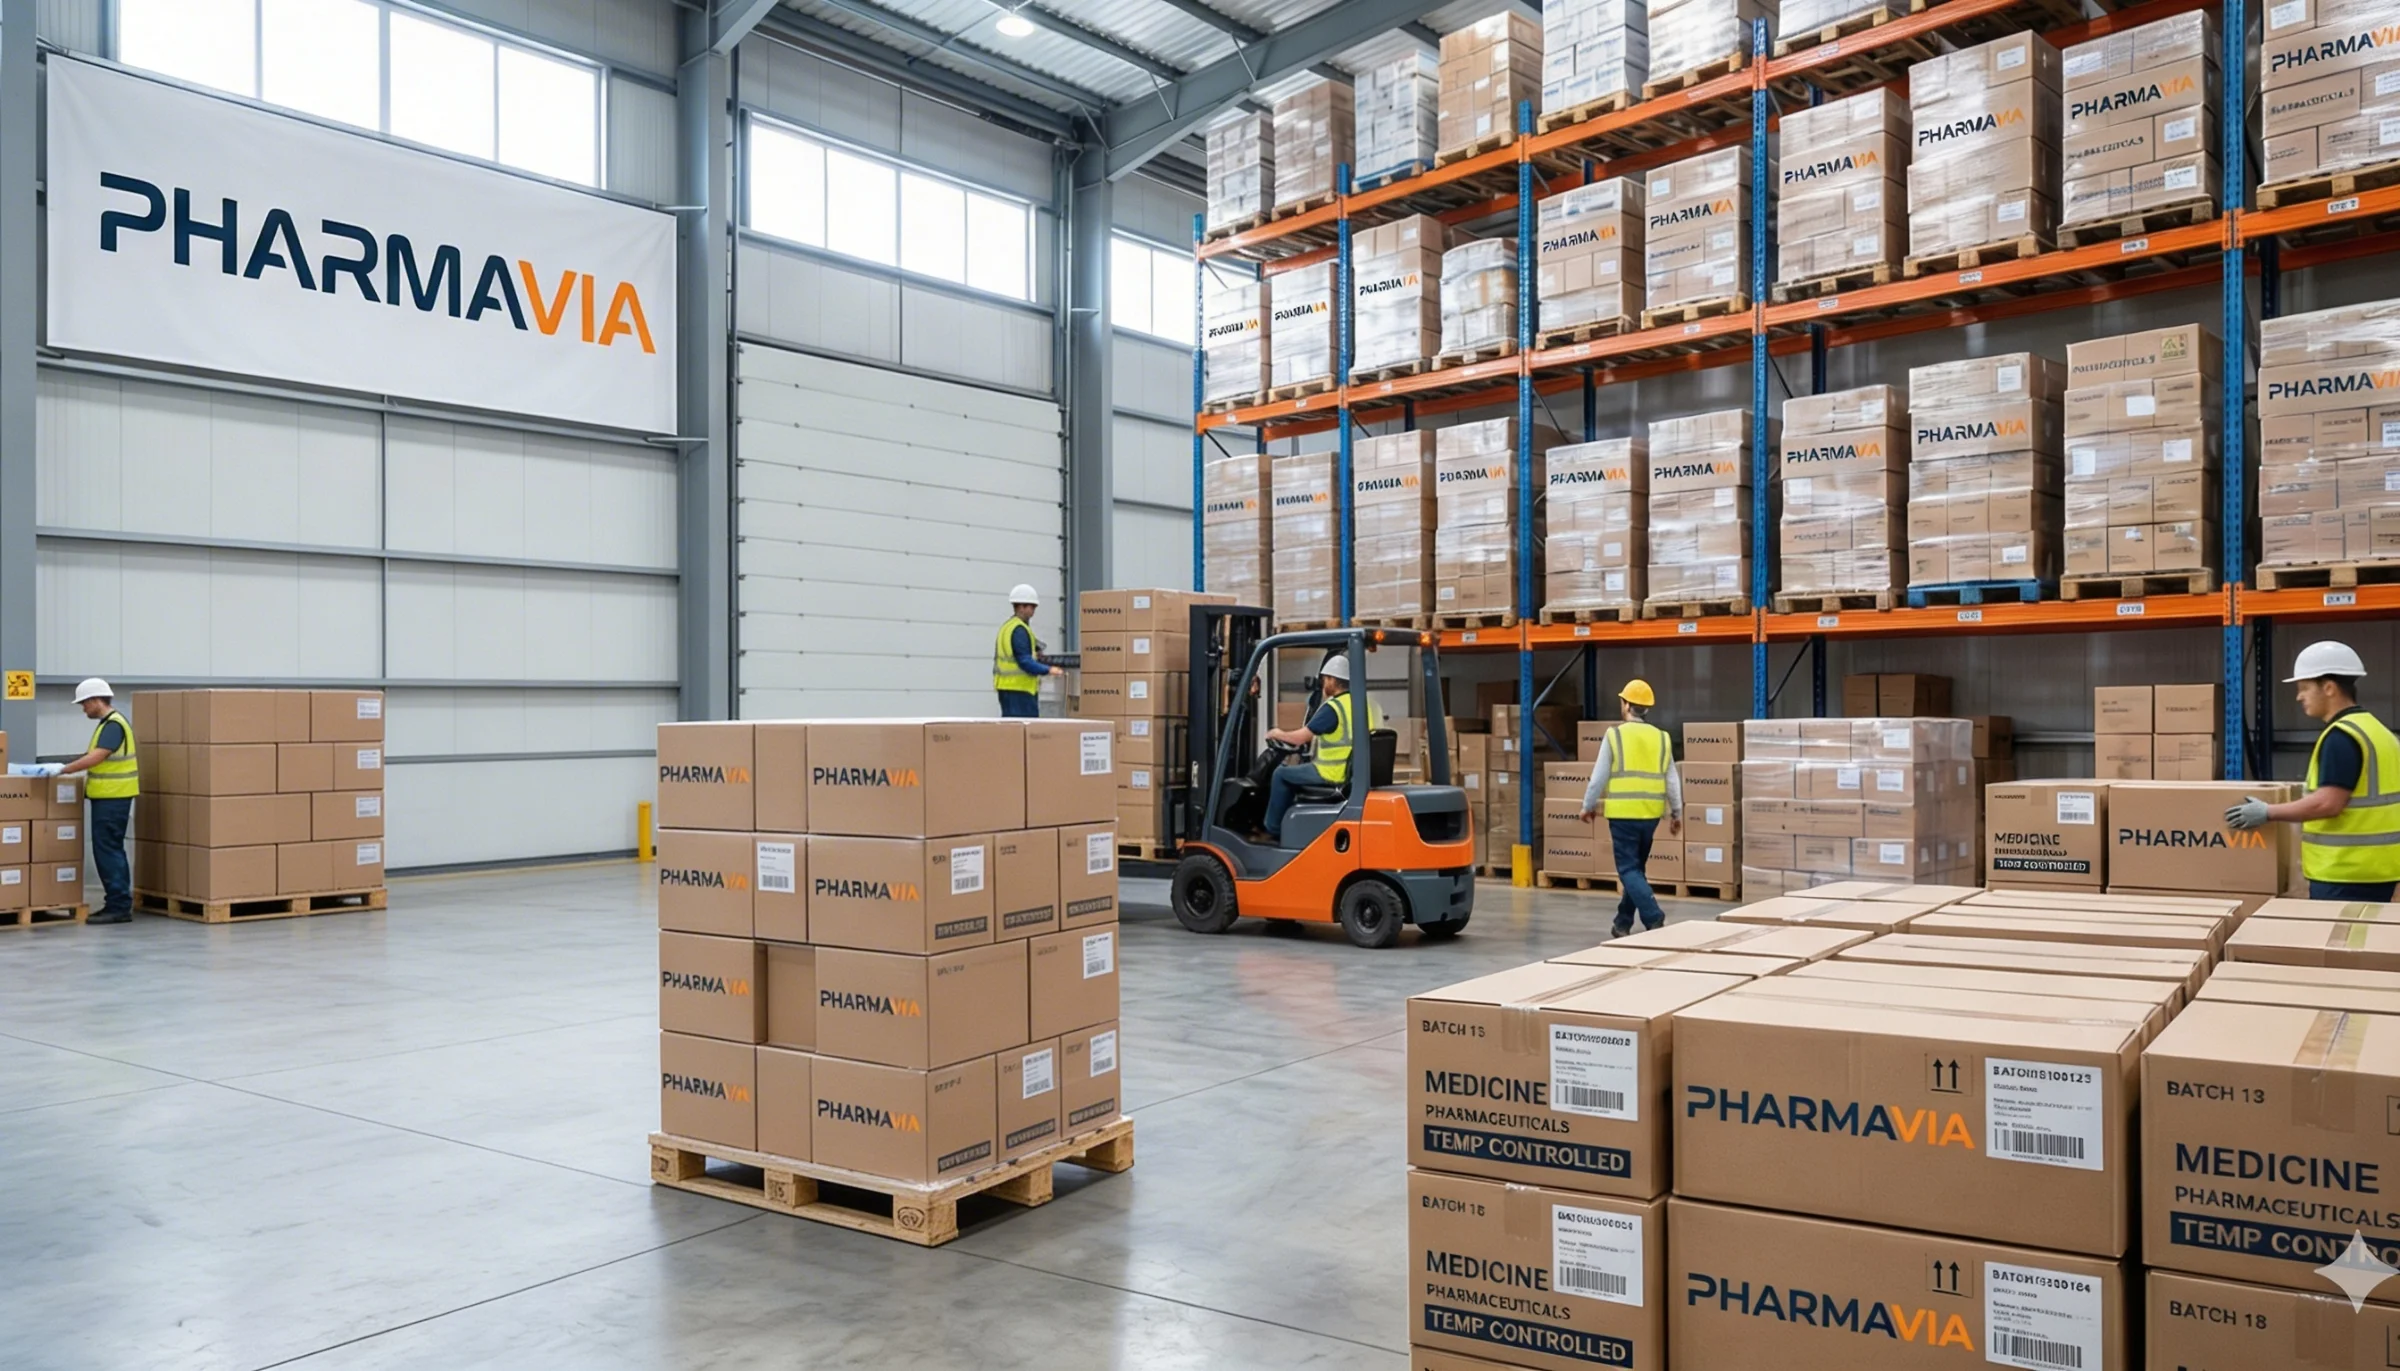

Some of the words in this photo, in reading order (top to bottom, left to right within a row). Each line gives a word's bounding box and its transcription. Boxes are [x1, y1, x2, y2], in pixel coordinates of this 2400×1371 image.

[2271, 25, 2400, 72] PHARMAVI
[2071, 74, 2195, 119] PHARMAVIA
[100, 171, 656, 354] PHARMAVIA
[2269, 371, 2400, 399] PHARMAVI
[1917, 418, 2027, 444] PHARMAVIA
[2118, 828, 2267, 849] PHARMAVIA
[815, 879, 920, 901] PHARMAVIA
[1422, 1020, 1466, 1036] BATCH
[1425, 1070, 1547, 1105] MEDICINE
[2167, 1081, 2234, 1102] BATCH
[2242, 1088, 2265, 1104] 13
[1425, 1104, 1570, 1134] PHARMACEUTICALS
[1687, 1084, 1975, 1149] PHARMAVIA
[1429, 1129, 1483, 1154] TEMP
[1489, 1137, 1624, 1172] CONTROLLED
[2176, 1143, 2380, 1194] MEDICINE
[1422, 1195, 1466, 1213] BATCH
[2175, 1186, 2400, 1230] PHARMACEUTICALS
[2179, 1218, 2262, 1249] TEMP
[1426, 1250, 1549, 1291] MEDICINE
[1426, 1283, 1571, 1320] PHARMACEUTICALS
[1687, 1272, 1975, 1351] PHARMAVIA
[2169, 1301, 2237, 1326] BATCH
[2244, 1313, 2267, 1330] 18
[1428, 1309, 1484, 1334] TEMP
[1489, 1320, 1626, 1361] CONTROLLED
